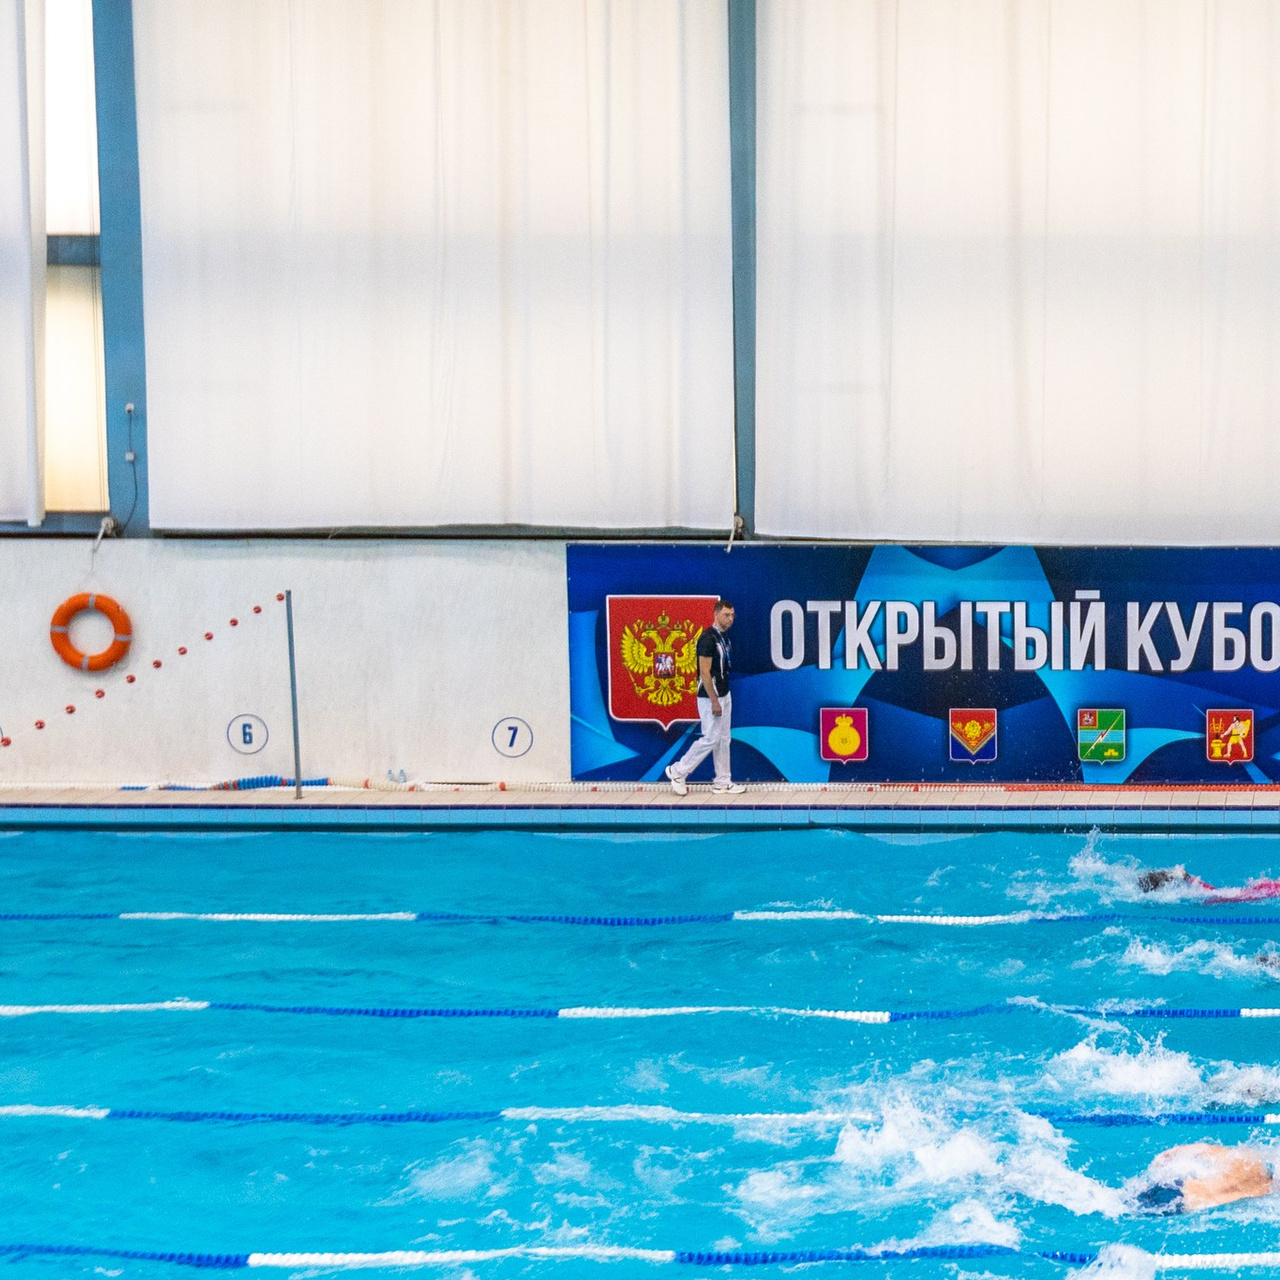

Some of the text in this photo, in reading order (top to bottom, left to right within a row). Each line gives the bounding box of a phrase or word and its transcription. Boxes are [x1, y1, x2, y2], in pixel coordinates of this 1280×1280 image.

[769, 589, 1106, 671] ОТКРЫТЫЙ
[242, 723, 253, 745] 6
[507, 725, 518, 747] 7
